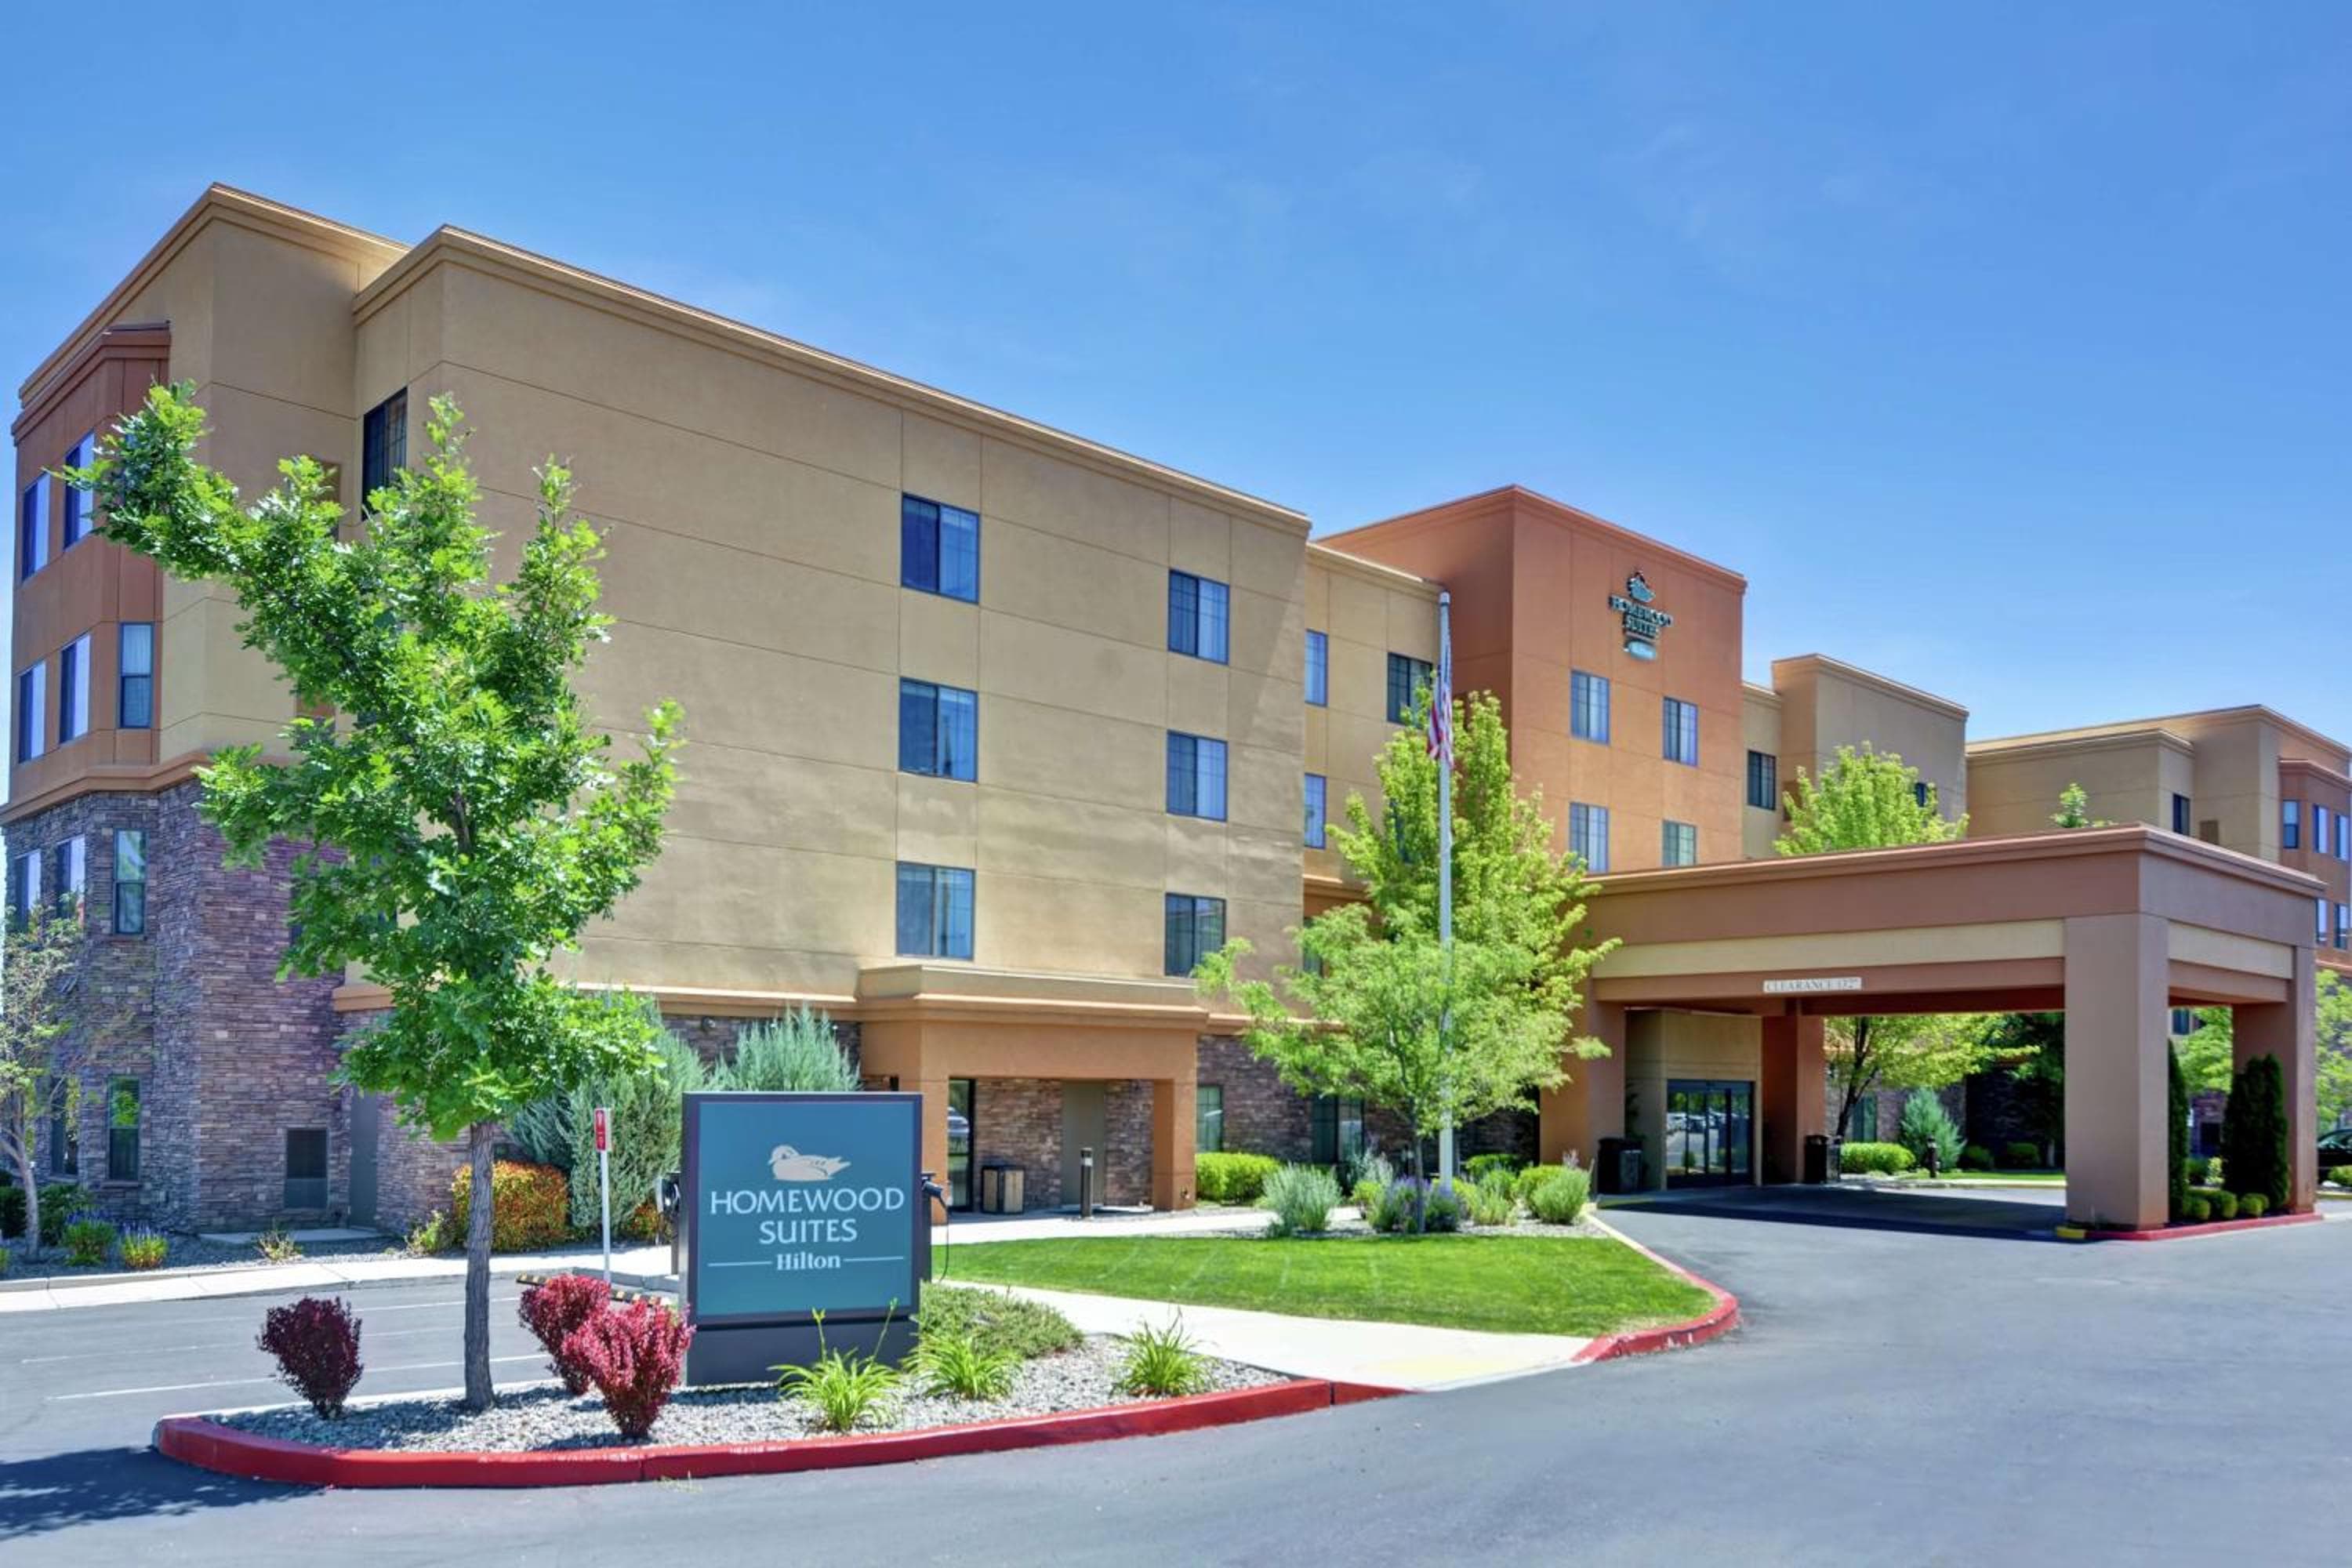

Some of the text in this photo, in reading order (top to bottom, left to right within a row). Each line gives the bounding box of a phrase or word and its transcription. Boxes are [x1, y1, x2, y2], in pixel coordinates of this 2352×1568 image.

[710, 1187, 905, 1214] HOMEWOOD
[759, 1218, 858, 1244] SUITES
[776, 1254, 841, 1271] Hilton
